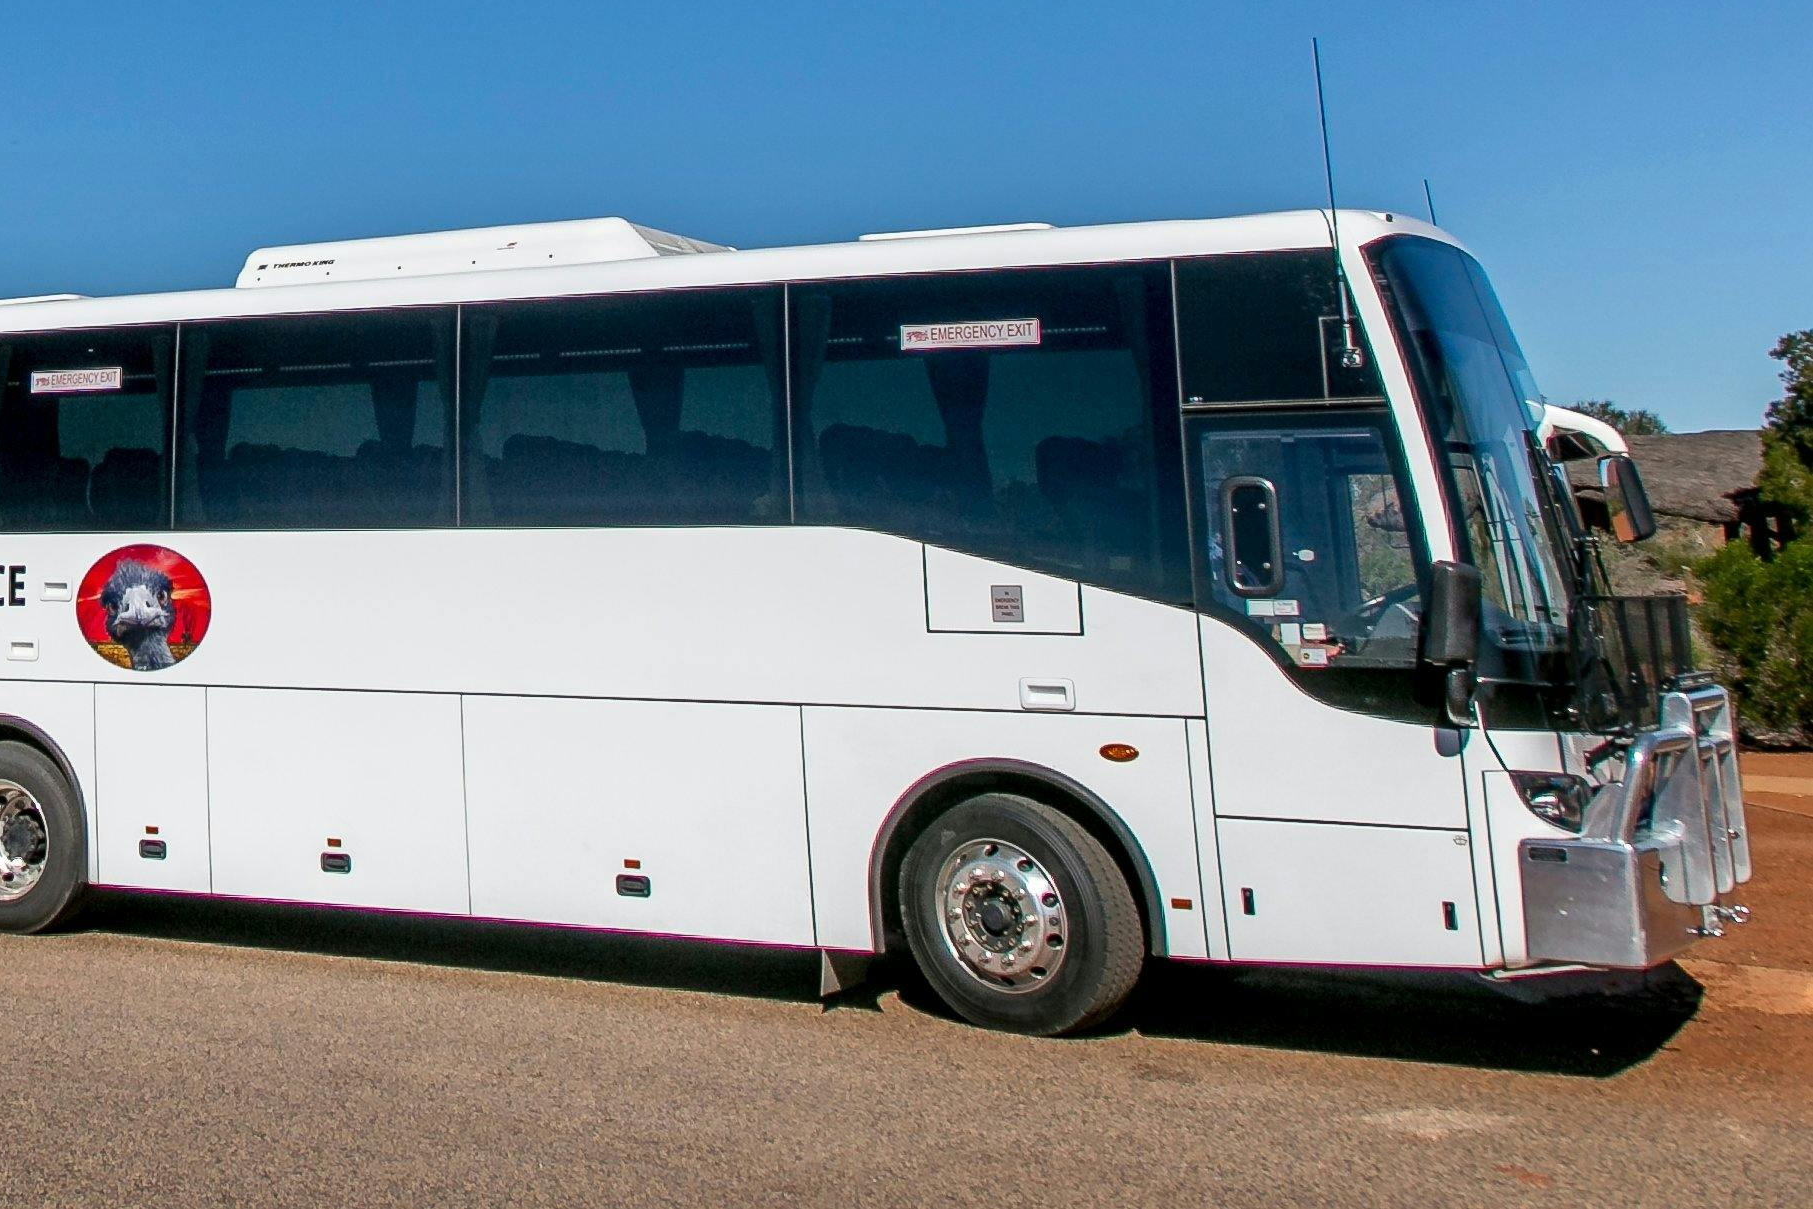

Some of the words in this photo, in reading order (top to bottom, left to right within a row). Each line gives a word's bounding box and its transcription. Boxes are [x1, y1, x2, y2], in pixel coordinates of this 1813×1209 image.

[273, 261, 311, 269] THERMO
[930, 324, 1004, 341] EMERGENCY
[1007, 322, 1033, 337] EXIT
[51, 372, 99, 386] EMERGENCY
[100, 370, 117, 383] EXIT
